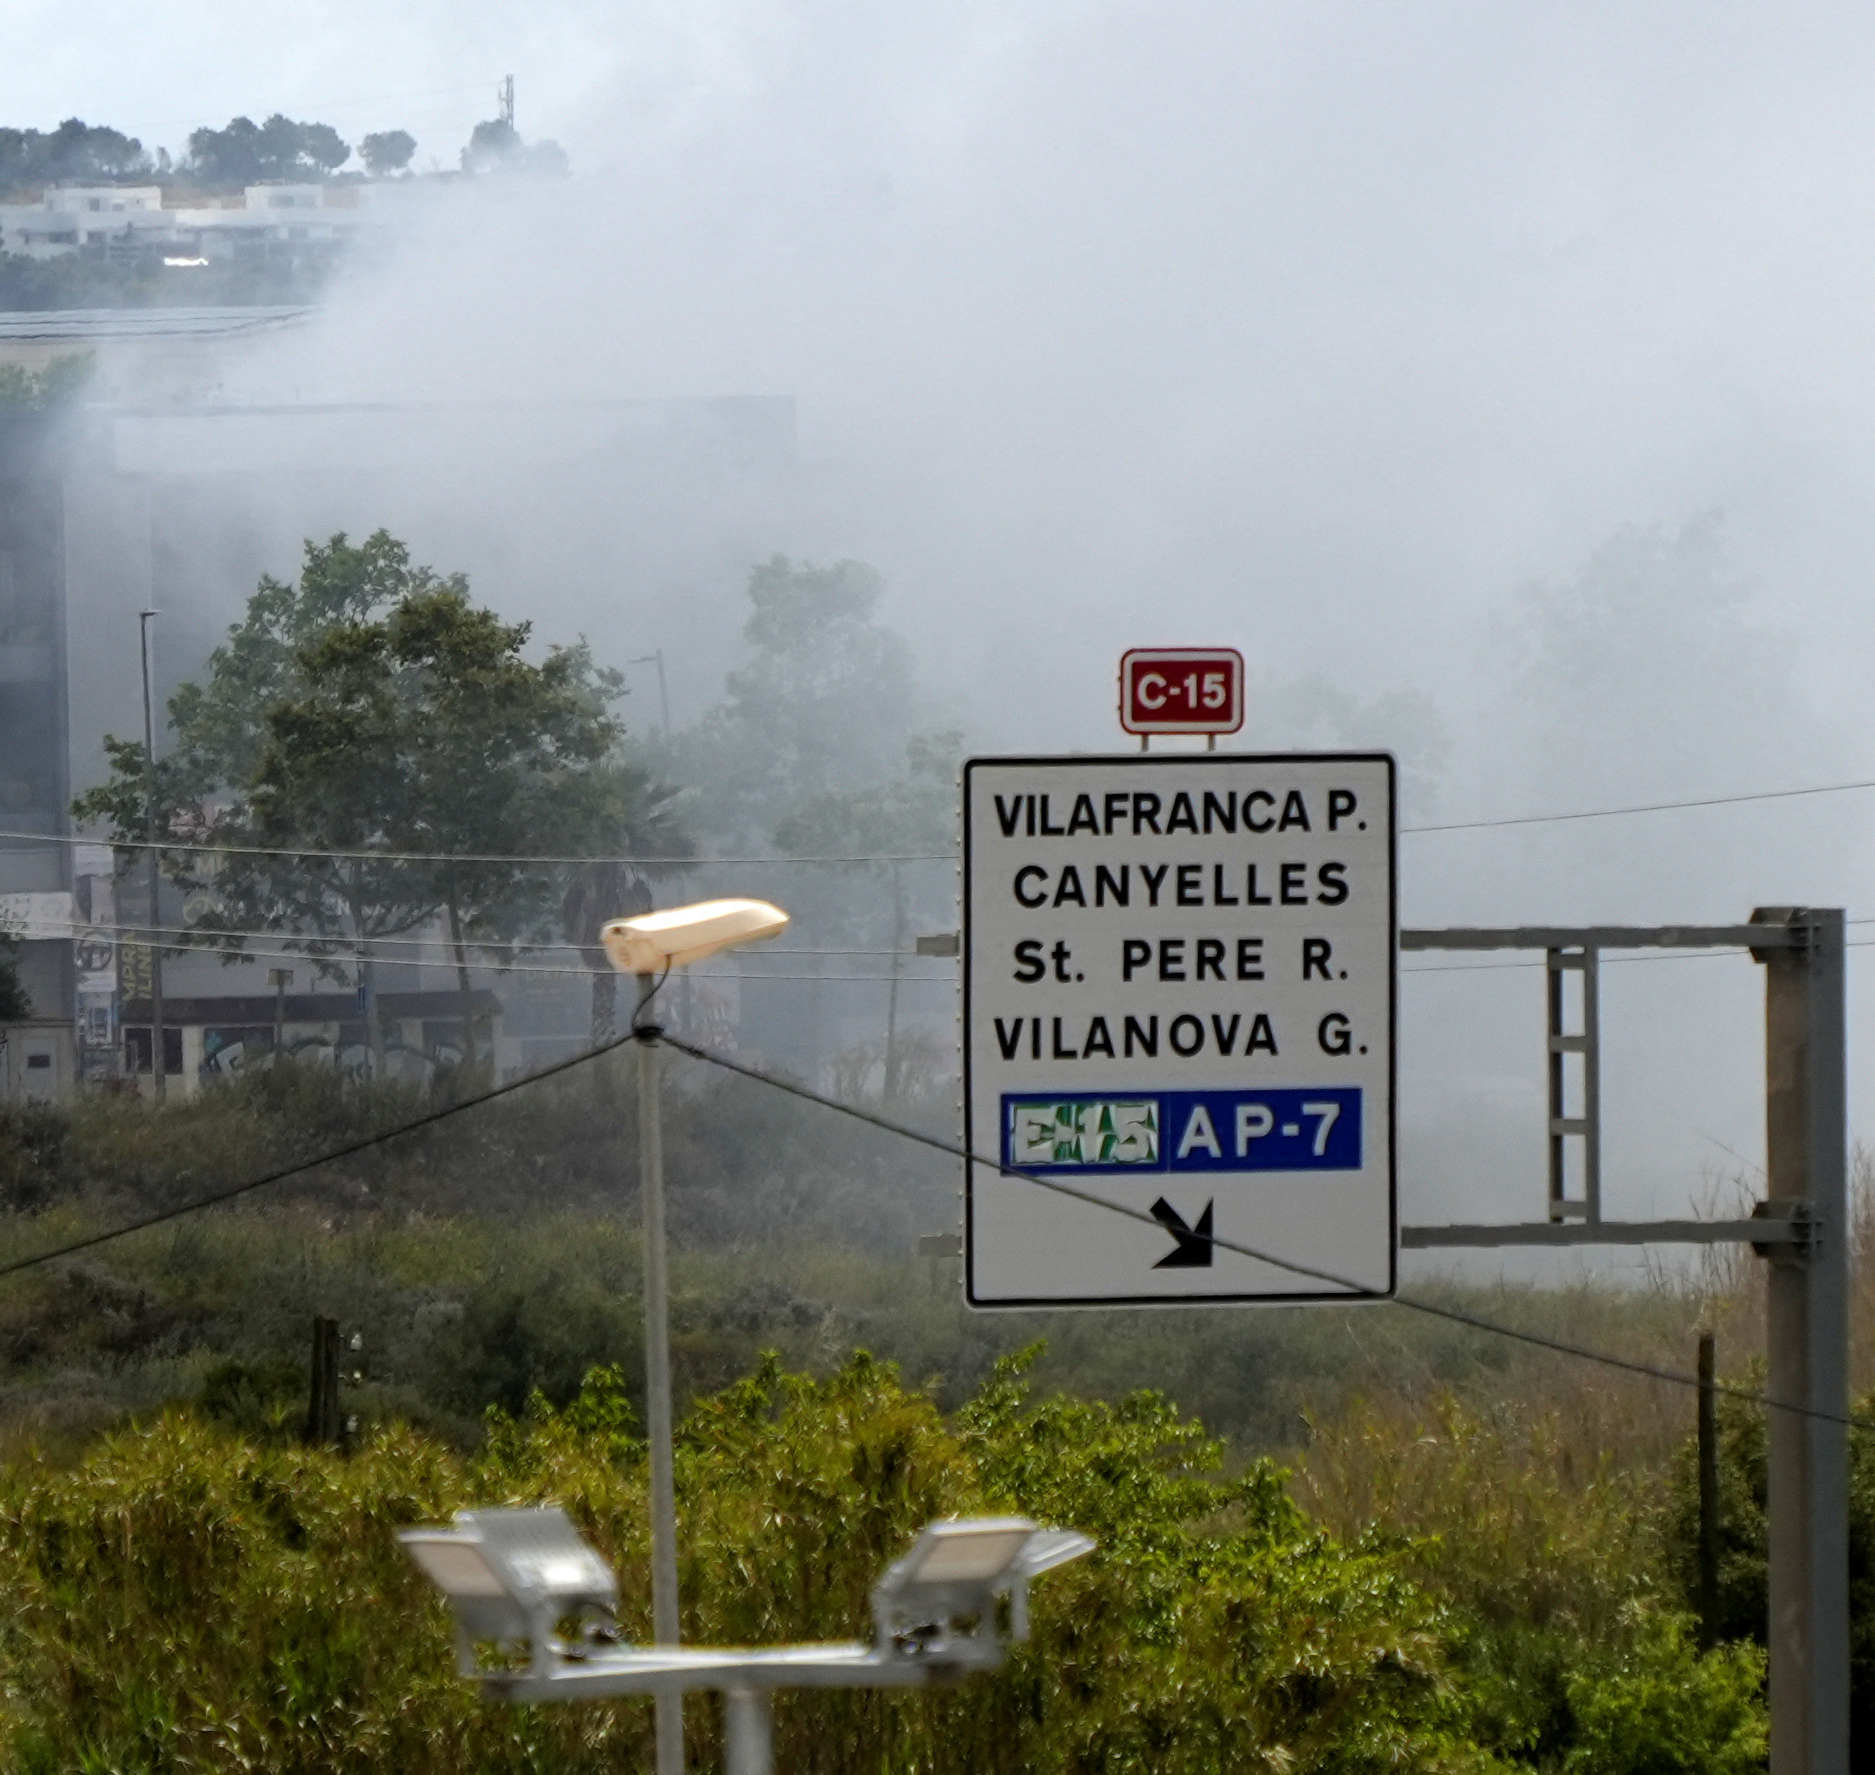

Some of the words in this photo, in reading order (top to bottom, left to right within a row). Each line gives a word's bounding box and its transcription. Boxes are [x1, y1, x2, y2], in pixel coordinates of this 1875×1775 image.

[1137, 673, 1227, 709] C-15
[995, 791, 1311, 837] VILAFRANCA
[1328, 790, 1368, 832] P.
[1013, 863, 1350, 909] CANYELLES
[1012, 939, 1085, 984] St.
[1122, 938, 1265, 983] PERE
[1303, 938, 1349, 981] R.
[995, 1014, 1279, 1061] VILANOVA
[1319, 1013, 1369, 1057] G.
[1177, 1103, 1341, 1159] AP-7
